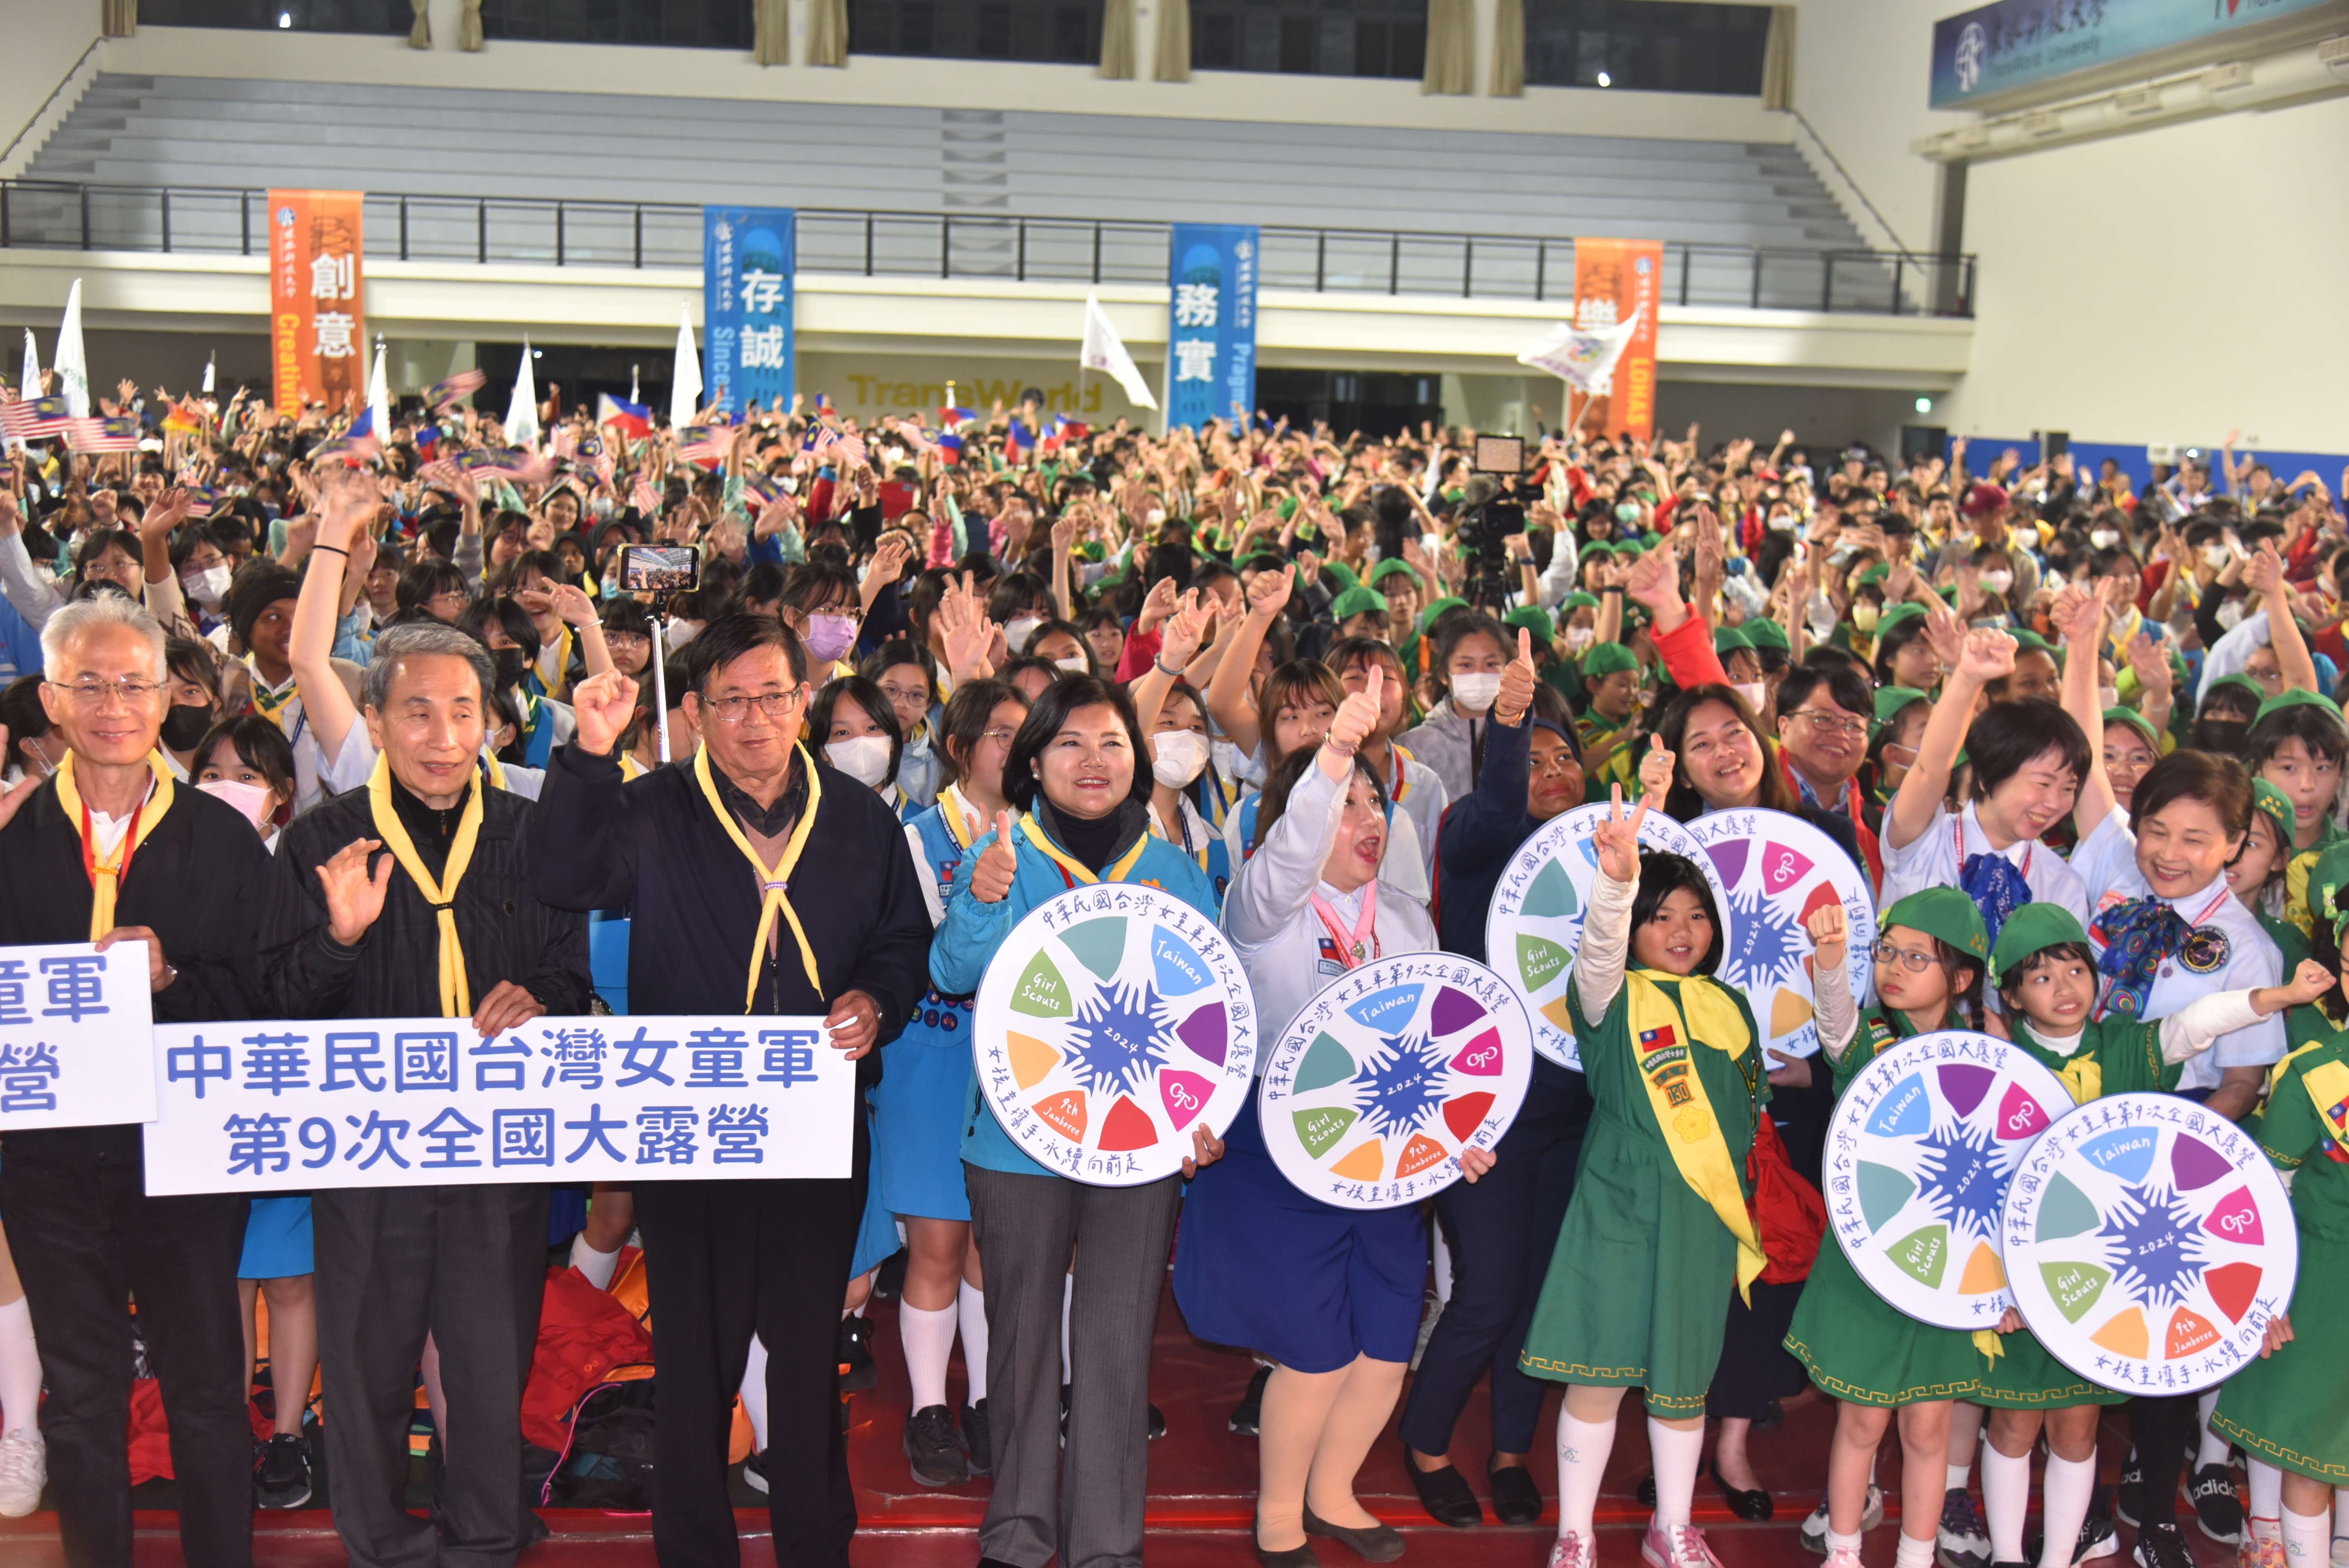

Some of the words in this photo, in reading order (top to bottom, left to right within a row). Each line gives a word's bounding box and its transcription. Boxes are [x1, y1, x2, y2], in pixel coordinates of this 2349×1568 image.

[310, 253, 356, 358] 創意
[740, 267, 785, 369] 存誠
[1174, 283, 1219, 383] 務實
[1626, 357, 1650, 426] LOHAS
[1743, 920, 1761, 956] 2024
[1156, 939, 1203, 985] Taiwan
[1527, 956, 1560, 977] Scouts
[1528, 945, 1547, 961] Girl
[1033, 972, 1057, 993] Girl
[1022, 985, 1060, 1010] Scouts
[1359, 992, 1415, 1023] Taiwan
[1104, 1026, 1139, 1054] 2024
[167, 1026, 819, 1099] 中華民國台灣女童軍
[1387, 1073, 1422, 1096] 2024
[1666, 1084, 1689, 1104] 130
[1062, 1097, 1079, 1116] 9th
[1878, 1087, 1921, 1133] Taiwan
[1043, 1106, 1080, 1136] Jamboree
[1308, 1113, 1330, 1132] Girl
[1309, 1119, 1344, 1146] Scouts
[223, 1103, 769, 1175] 第9次全國大露營
[1409, 1142, 1428, 1158] 9th
[2093, 1137, 2151, 1167] Taiwan
[1405, 1149, 1442, 1173] Jamboree
[1956, 1159, 1982, 1195] 2024
[1906, 1239, 1924, 1264] Girl
[1918, 1237, 1941, 1277] Scouts
[2138, 1232, 2175, 1256] 2024
[2057, 1269, 2081, 1290] Girl
[2062, 1278, 2098, 1307] Scouts
[2175, 1317, 2196, 1334] 9th
[2174, 1329, 2214, 1354] Jamboree
